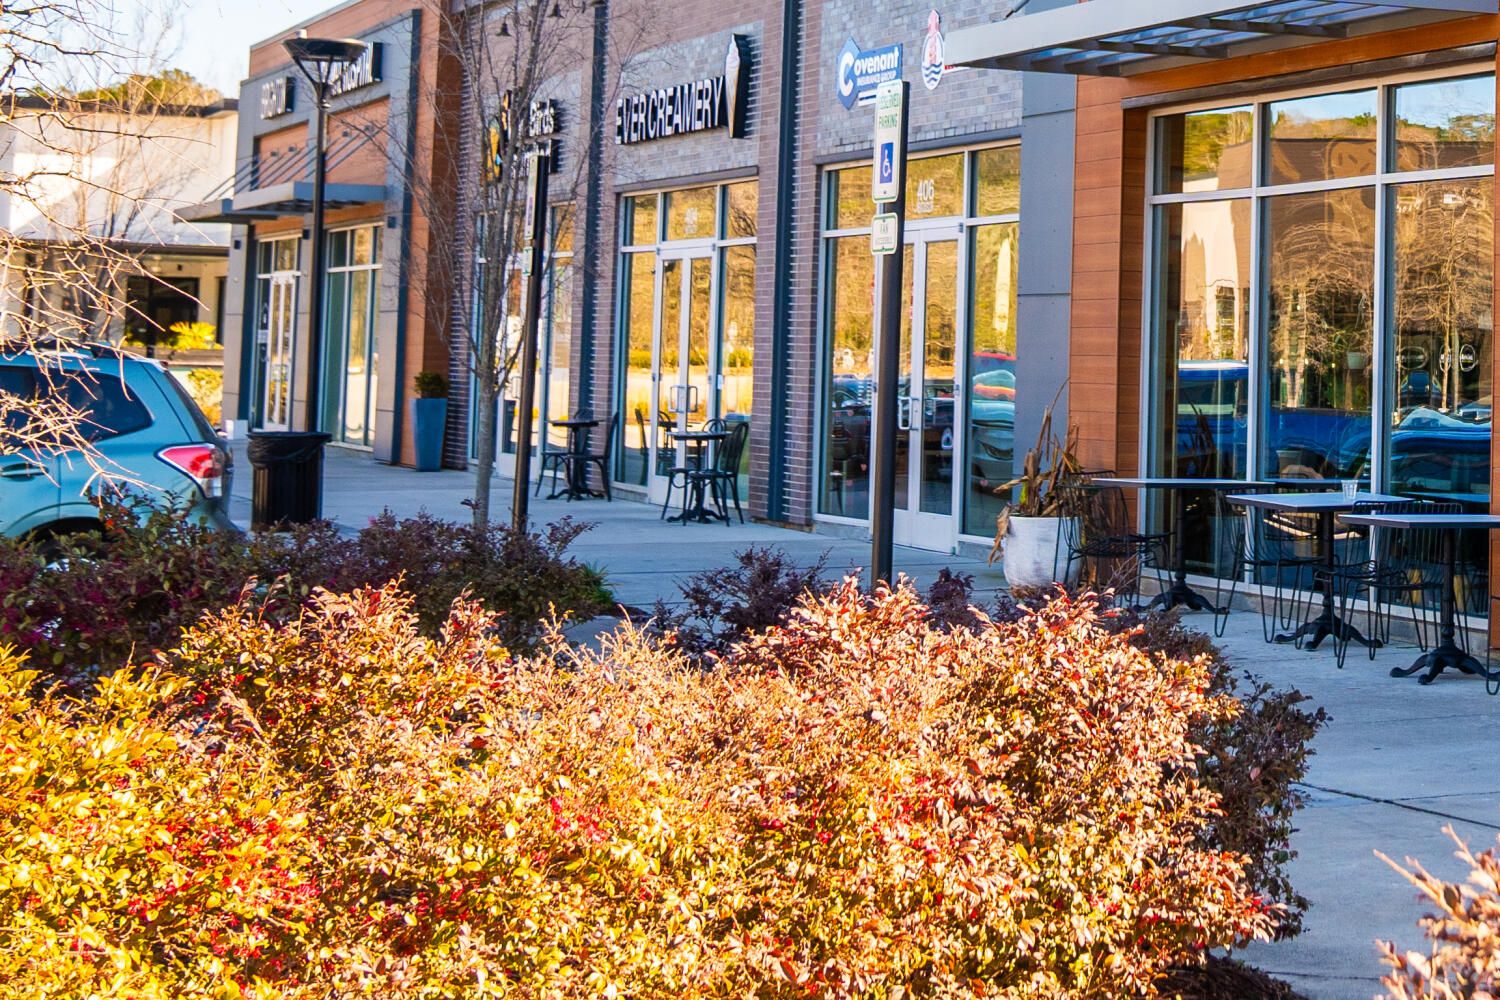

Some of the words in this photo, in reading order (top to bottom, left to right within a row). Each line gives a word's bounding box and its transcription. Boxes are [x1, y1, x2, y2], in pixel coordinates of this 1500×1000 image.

[839, 46, 900, 97] Covenant
[878, 112, 898, 129] PARKING
[916, 179, 935, 201] 406
